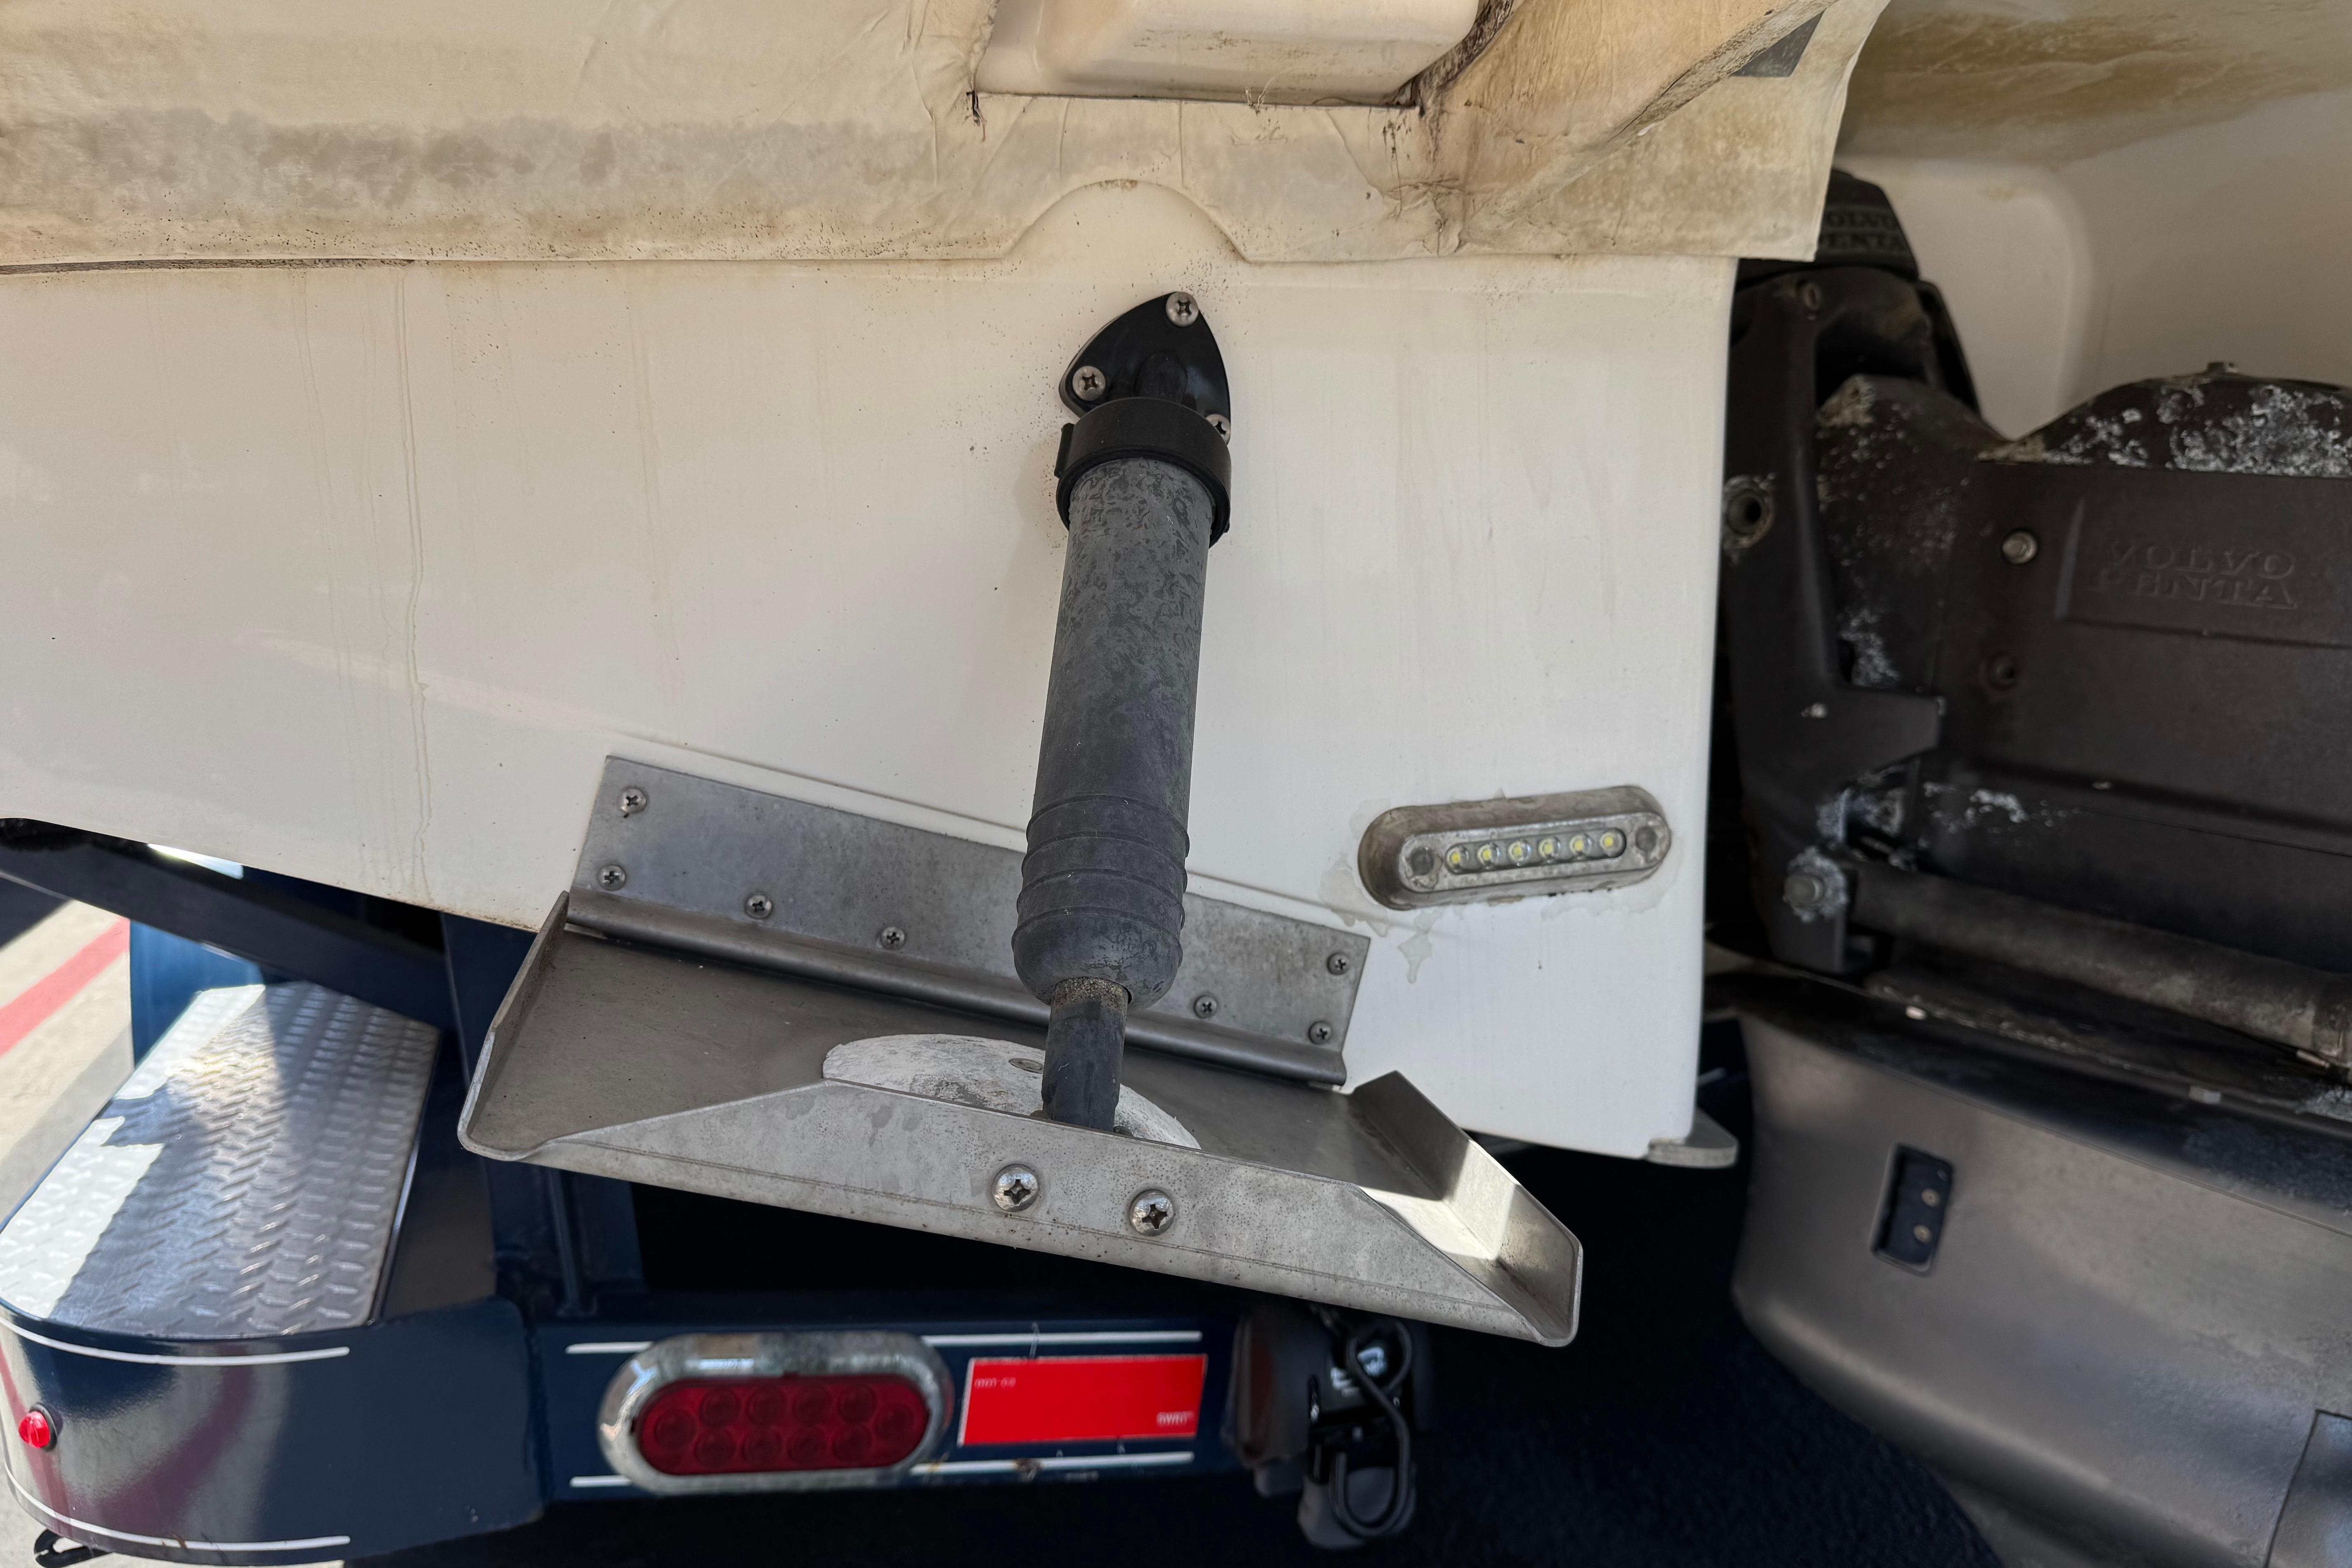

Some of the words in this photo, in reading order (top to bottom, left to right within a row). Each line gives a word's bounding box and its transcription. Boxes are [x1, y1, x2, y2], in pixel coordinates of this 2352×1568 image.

[1825, 211, 1897, 229] OLVO
[2109, 539, 2295, 580] VOLVO
[2084, 568, 2298, 609] PENTA
